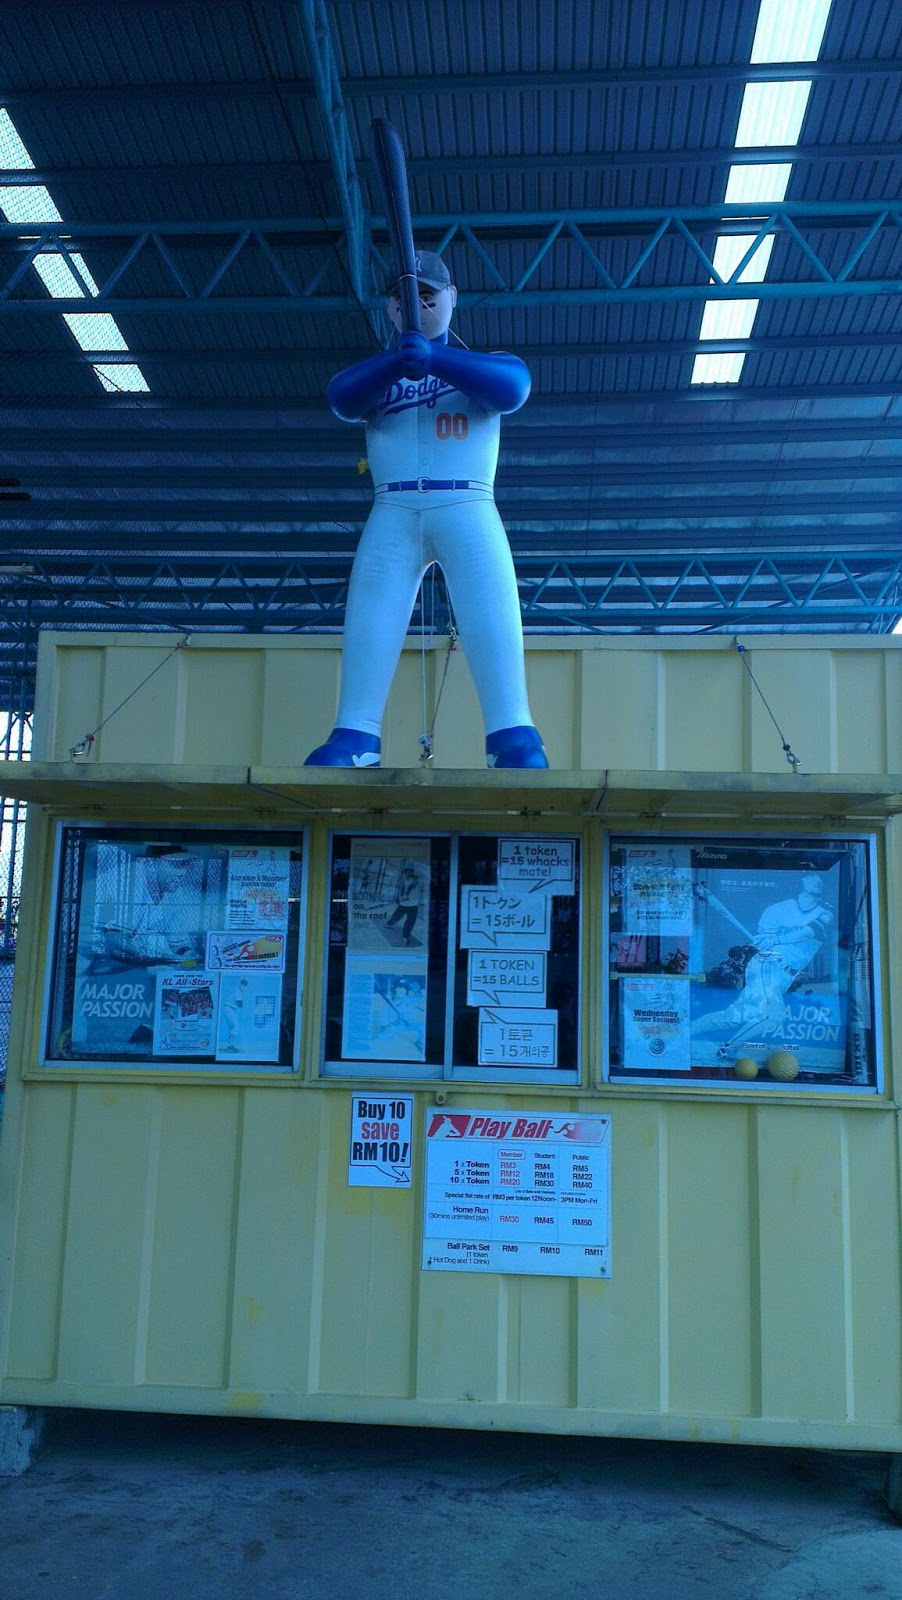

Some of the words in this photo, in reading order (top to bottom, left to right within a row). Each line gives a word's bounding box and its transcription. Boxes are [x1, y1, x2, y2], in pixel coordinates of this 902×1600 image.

[379, 373, 450, 409] Dodge
[436, 412, 468, 440] 00
[514, 845, 521, 855] 1
[525, 845, 558, 856] token
[501, 857, 524, 866] =15
[527, 856, 569, 867] whacks
[519, 867, 552, 877] mate!
[479, 960, 487, 969] 1
[490, 959, 535, 971] TOKEN
[473, 975, 496, 984] =15
[500, 975, 539, 986] BALLS
[81, 983, 146, 1000] MAJOR
[79, 1000, 153, 1018] PASSION
[633, 1009, 679, 1018] Wednesday
[784, 1004, 831, 1023] AJOR
[761, 1023, 840, 1042] PASSION
[358, 1100, 386, 1120] Buy
[389, 1101, 406, 1119] 10
[361, 1121, 400, 1140] save
[468, 1117, 512, 1140] Play
[511, 1118, 553, 1139] Ball
[466, 1160, 490, 1168] Token
[500, 1161, 517, 1169] RM3
[572, 1164, 589, 1172] RM5
[466, 1169, 490, 1177] Token
[572, 1173, 593, 1181] RM22
[466, 1177, 490, 1185] Token
[500, 1178, 521, 1186] RM20
[534, 1179, 555, 1187] RM30
[572, 1181, 593, 1189] RM40
[452, 1205, 474, 1213] Home
[474, 1206, 489, 1214] Run
[476, 1214, 490, 1222] play)
[499, 1215, 519, 1223] RM30
[534, 1216, 554, 1224] RM45
[572, 1218, 592, 1226] RM50
[447, 1242, 460, 1250] Ball
[478, 1243, 490, 1251] Set
[502, 1245, 519, 1253] RM9
[540, 1246, 560, 1254] RM10
[584, 1248, 603, 1256] RM11
[444, 1257, 456, 1265] Dog
